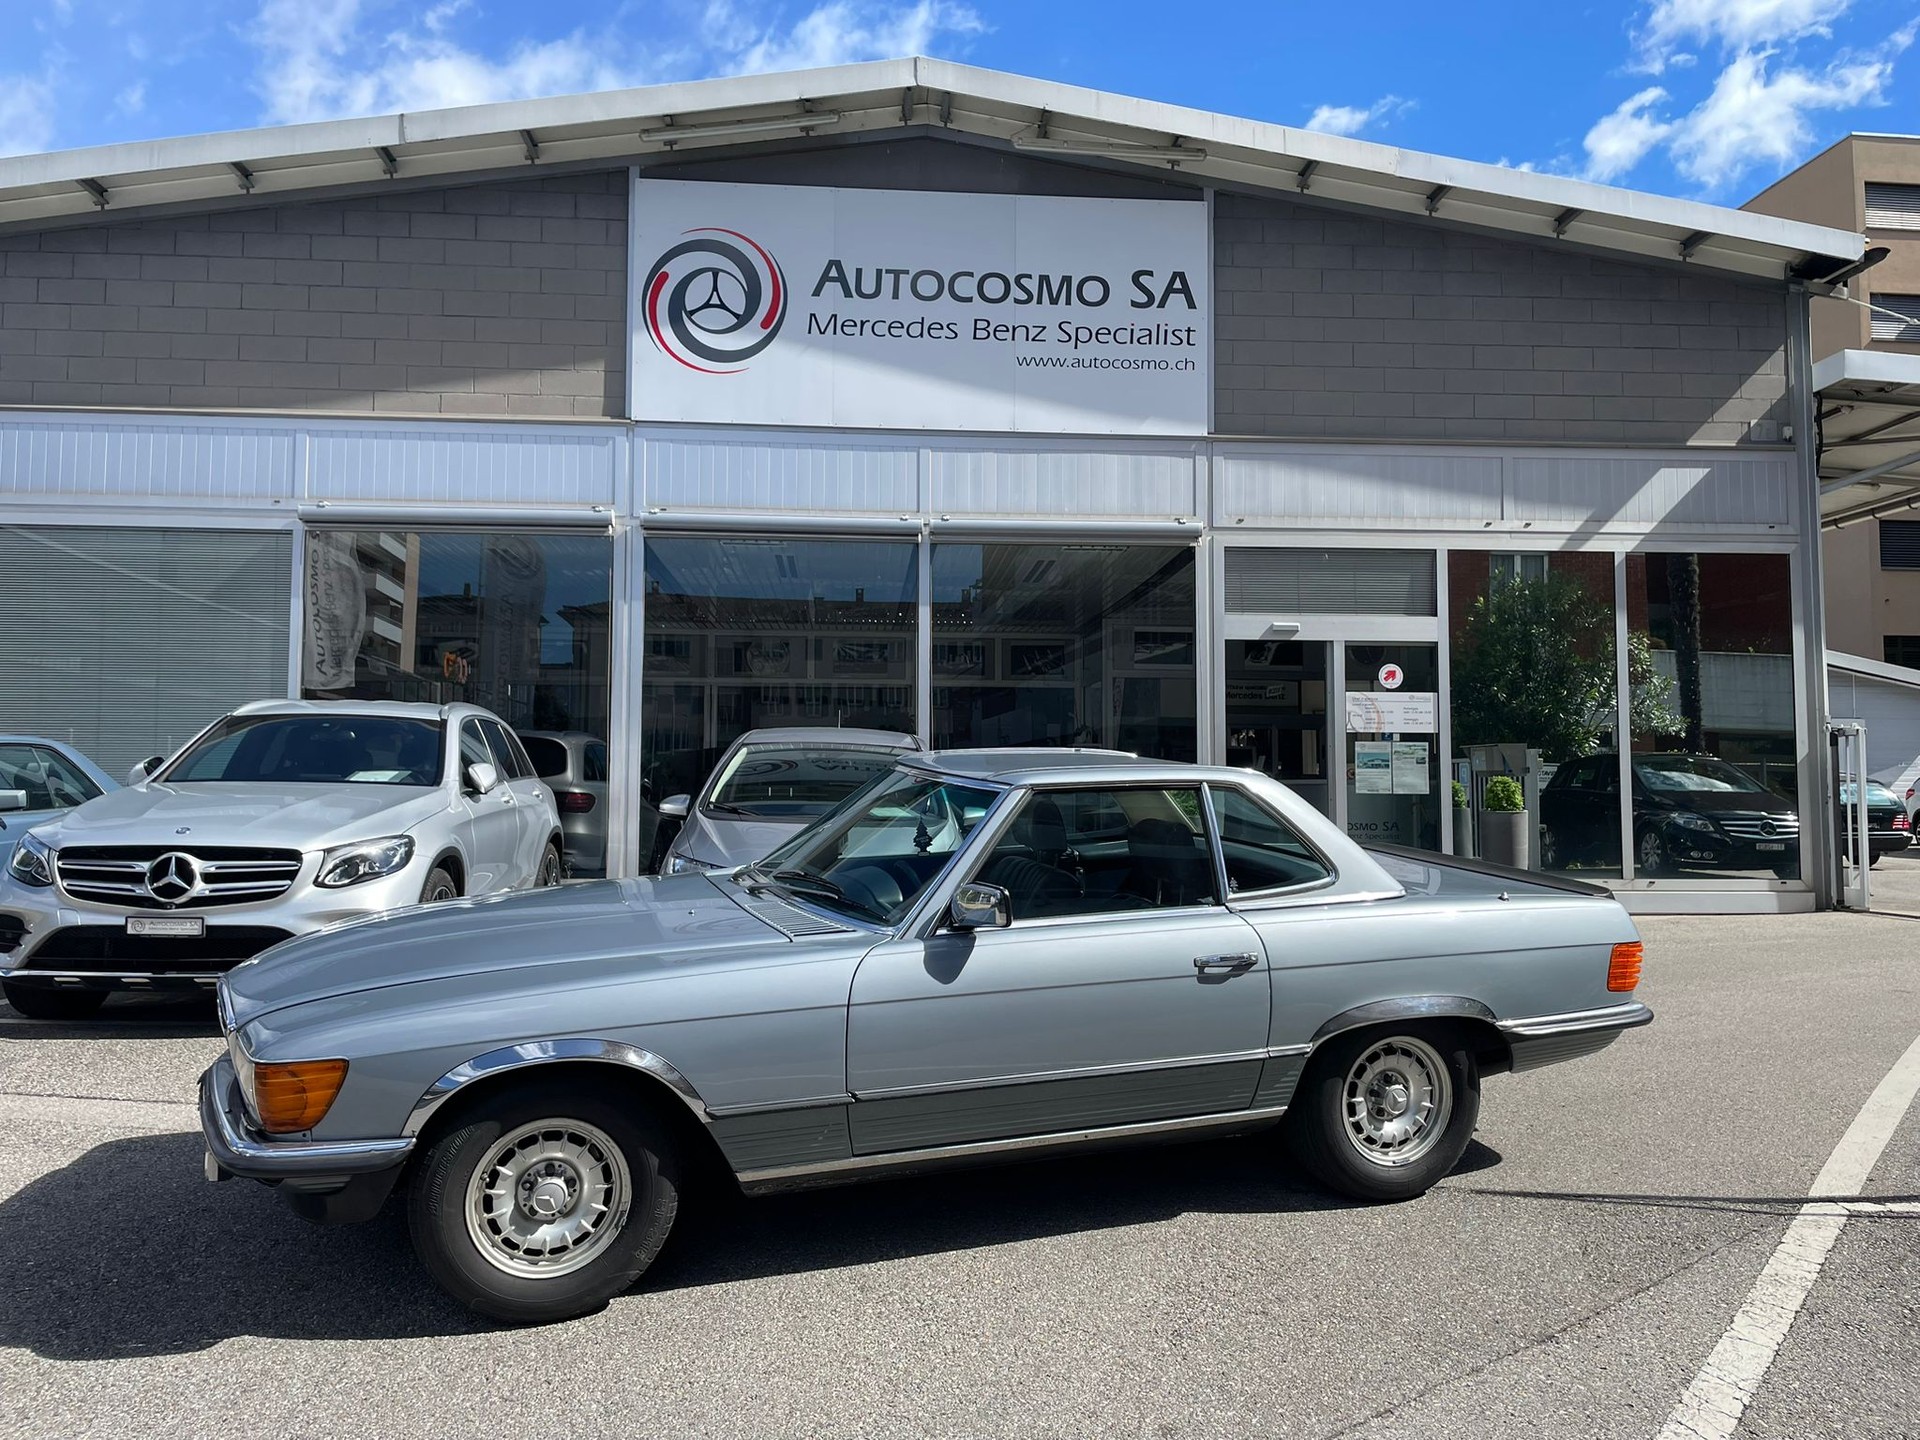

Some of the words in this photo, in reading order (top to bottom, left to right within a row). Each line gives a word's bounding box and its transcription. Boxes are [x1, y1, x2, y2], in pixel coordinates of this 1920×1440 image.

[1130, 269, 1197, 310] SA
[807, 312, 959, 340] Mercedes
[972, 318, 1047, 342] Benz
[1057, 320, 1197, 350] Specialist
[1016, 356, 1196, 372] www.autocosmo.ch
[1382, 821, 1400, 832] SA
